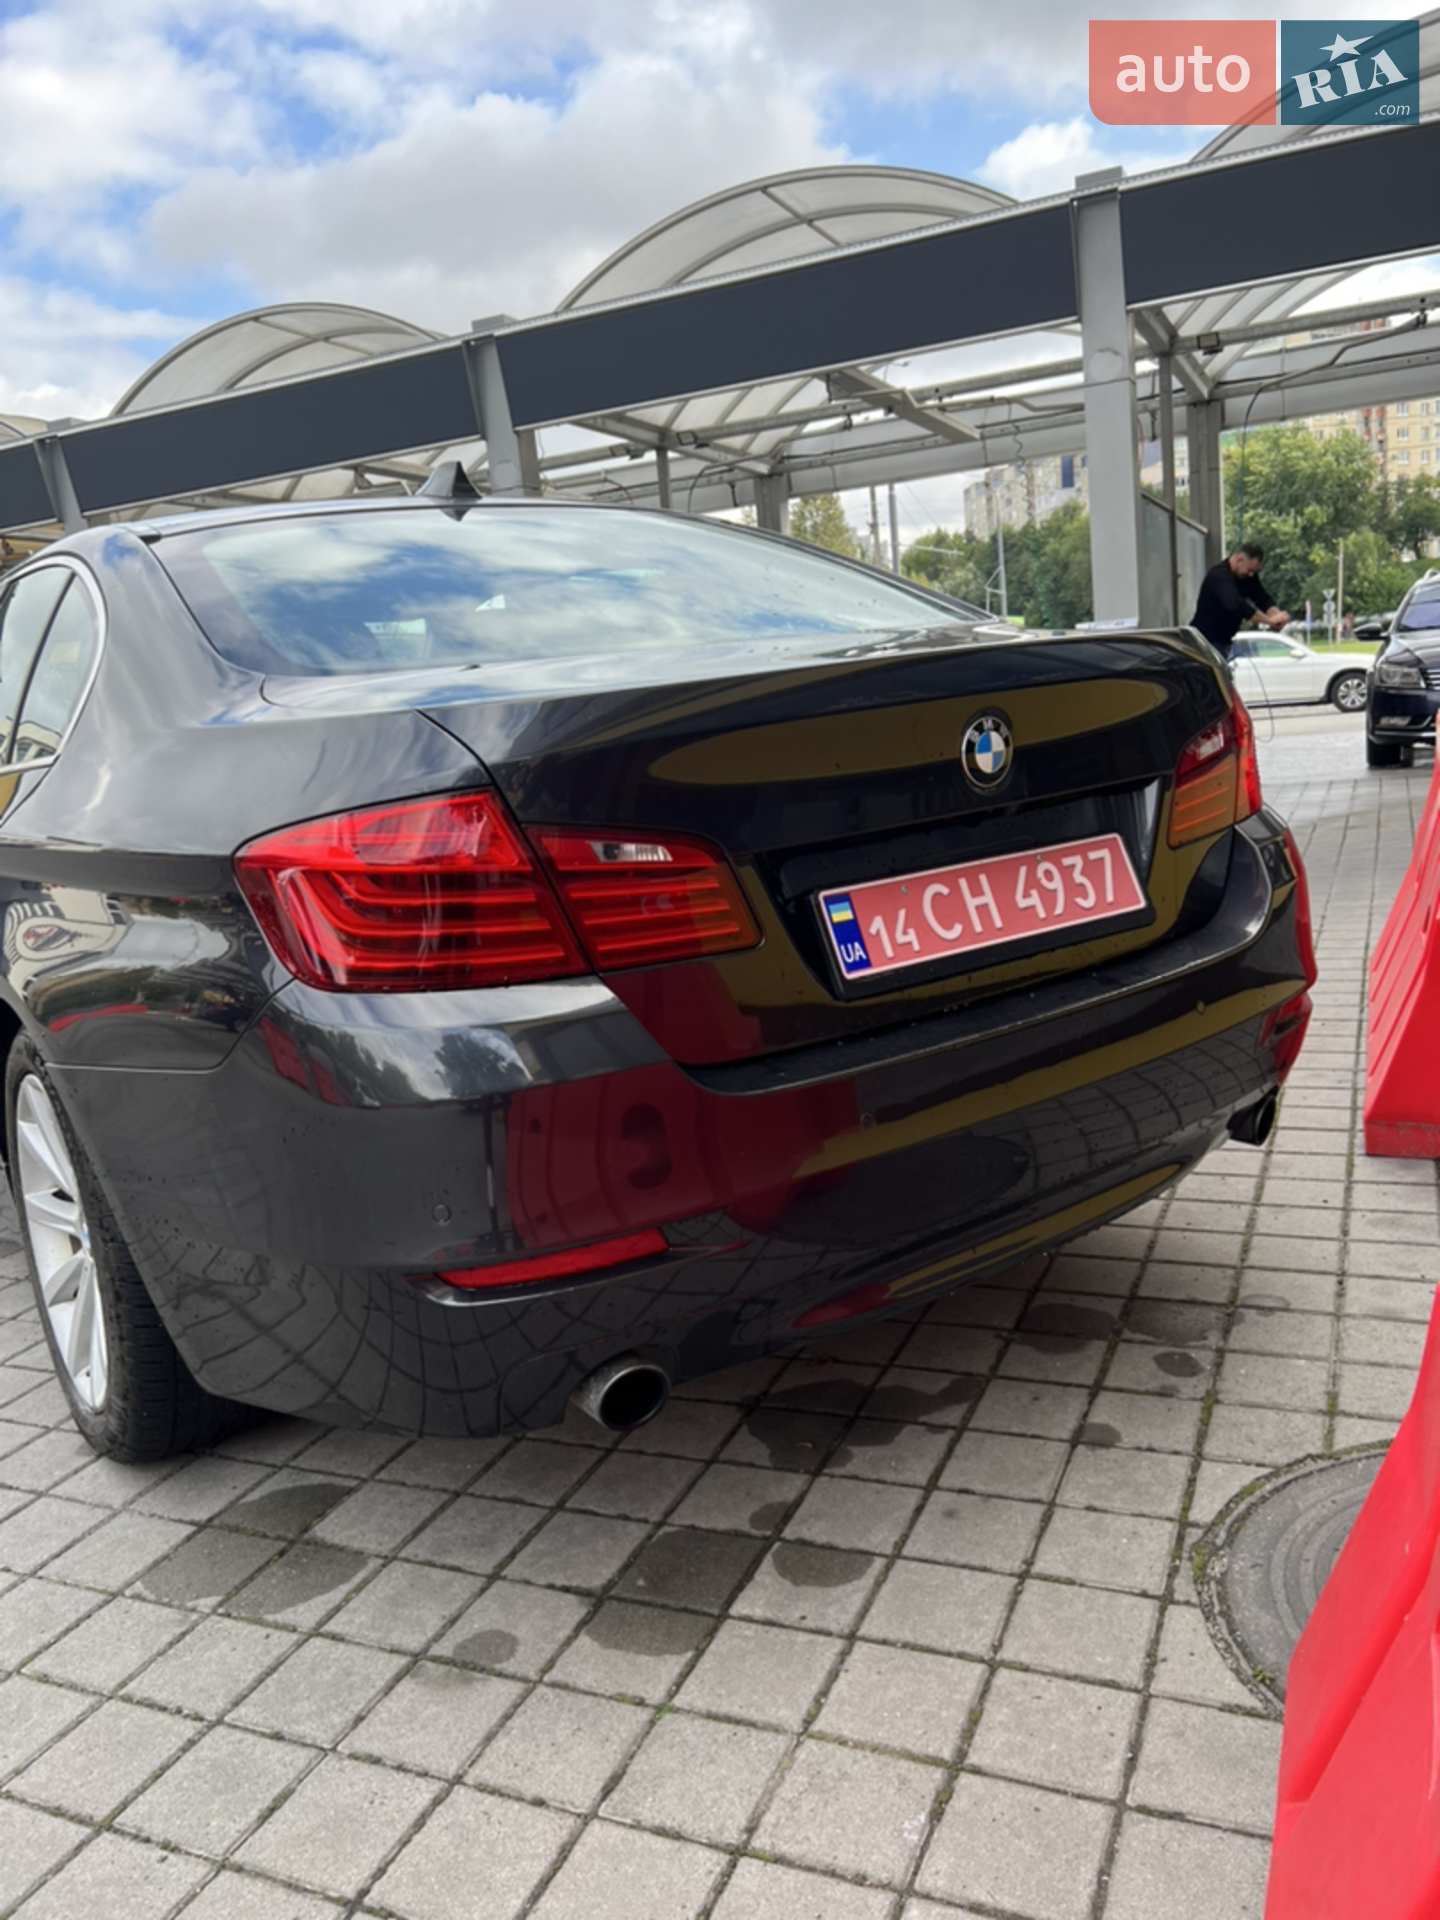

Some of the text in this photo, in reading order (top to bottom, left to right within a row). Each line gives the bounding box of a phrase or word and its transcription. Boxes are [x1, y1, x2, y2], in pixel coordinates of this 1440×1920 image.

[868, 848, 1115, 959] 14 CH 4937
[840, 942, 867, 963] UA
